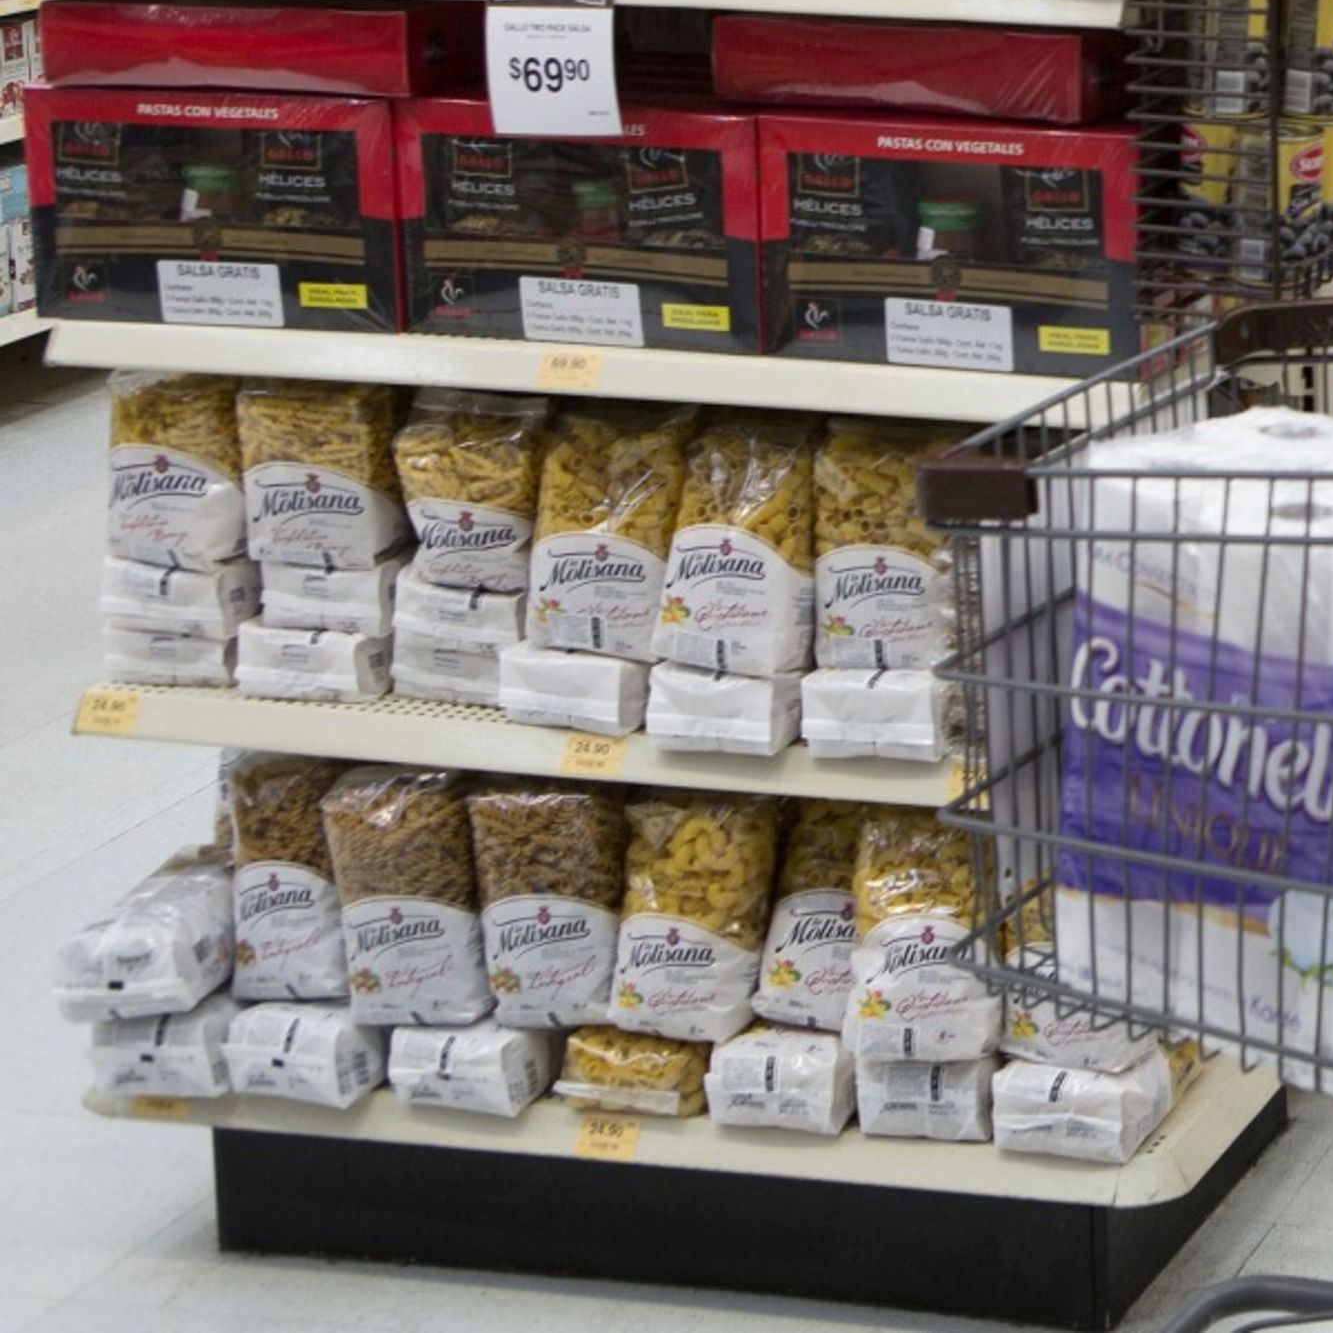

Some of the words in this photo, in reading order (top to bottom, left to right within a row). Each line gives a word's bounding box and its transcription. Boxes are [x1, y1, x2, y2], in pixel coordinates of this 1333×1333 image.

[137, 104, 181, 117] PASTAS
[184, 105, 212, 118] CON
[214, 105, 279, 120] VEGETALES
[877, 136, 922, 151] PASTAS
[926, 138, 953, 153] CON
[956, 140, 1024, 157] VEGETALES
[177, 264, 216, 278] SALSA
[218, 266, 260, 280] GRATIS
[538, 280, 576, 296] SALSA
[578, 284, 621, 300] GRATIS
[905, 302, 945, 318] SALSA
[948, 304, 991, 323] GRATIS
[111, 473, 208, 505] Molisana
[253, 488, 364, 524] Molisana
[419, 519, 517, 549] Molisana
[540, 556, 647, 592] Molisana
[666, 553, 766, 588] Molisana
[824, 573, 926, 609] Molisana
[574, 741, 611, 755] 24.90
[351, 915, 446, 961] Molisana
[496, 915, 592, 957] Molisana
[776, 914, 855, 953] Molisa
[621, 941, 717, 975] Molisana
